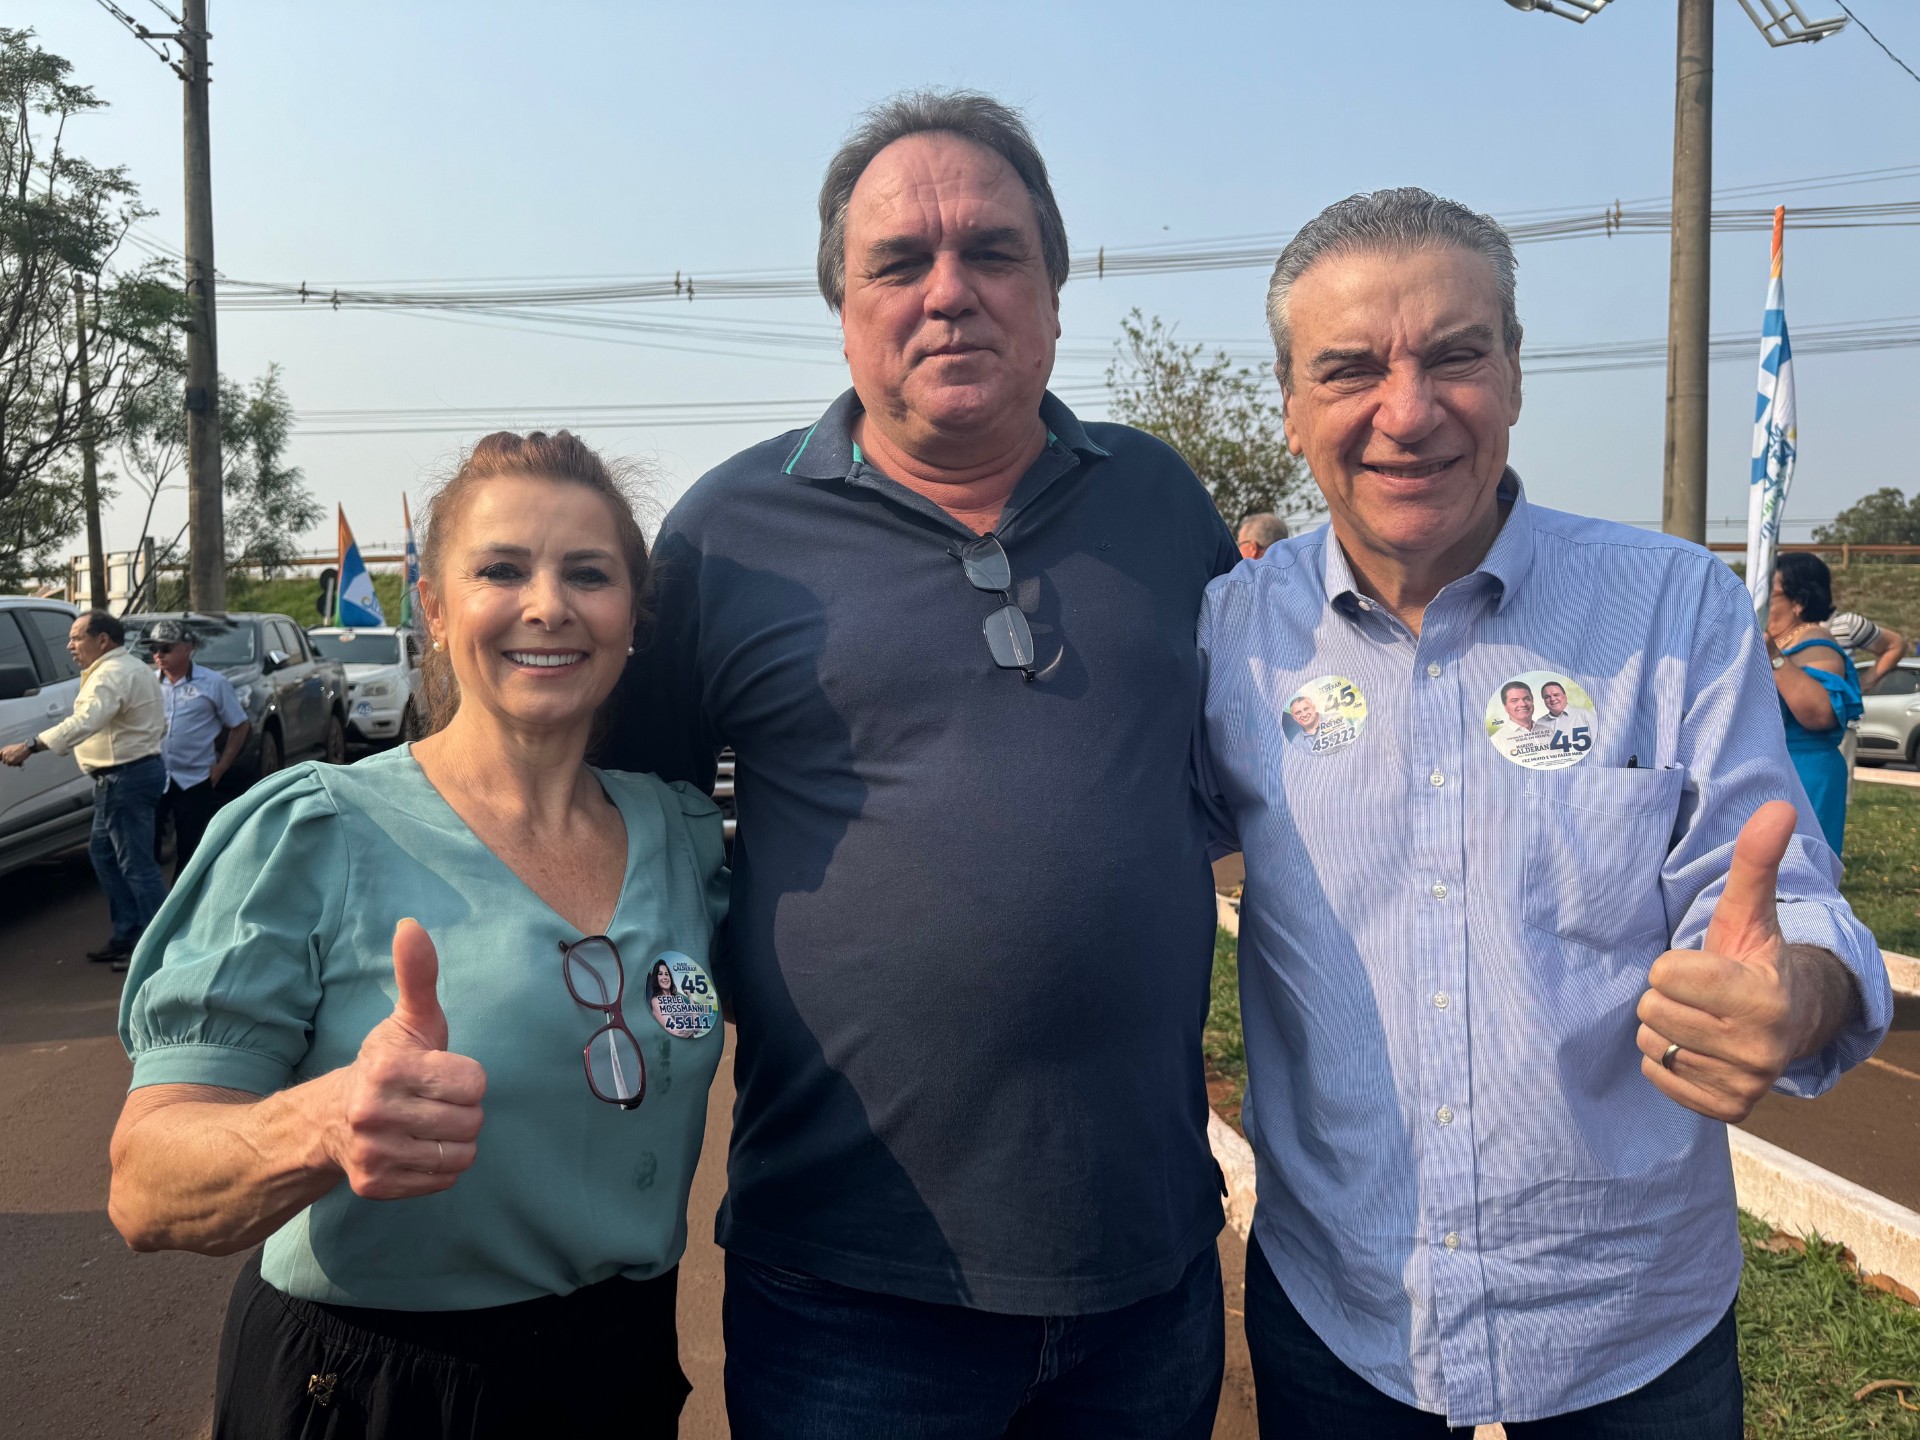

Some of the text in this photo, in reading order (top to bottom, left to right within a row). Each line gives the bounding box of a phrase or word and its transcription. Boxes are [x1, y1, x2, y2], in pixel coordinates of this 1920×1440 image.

[1325, 685, 1355, 713] 45
[1312, 727, 1356, 752] 45.222
[1510, 744, 1550, 756] CALDERAN
[1550, 726, 1592, 753] 45
[681, 974, 708, 995] 45
[658, 995, 684, 1005] SERLEI
[660, 1004, 703, 1013] MOSSMANN
